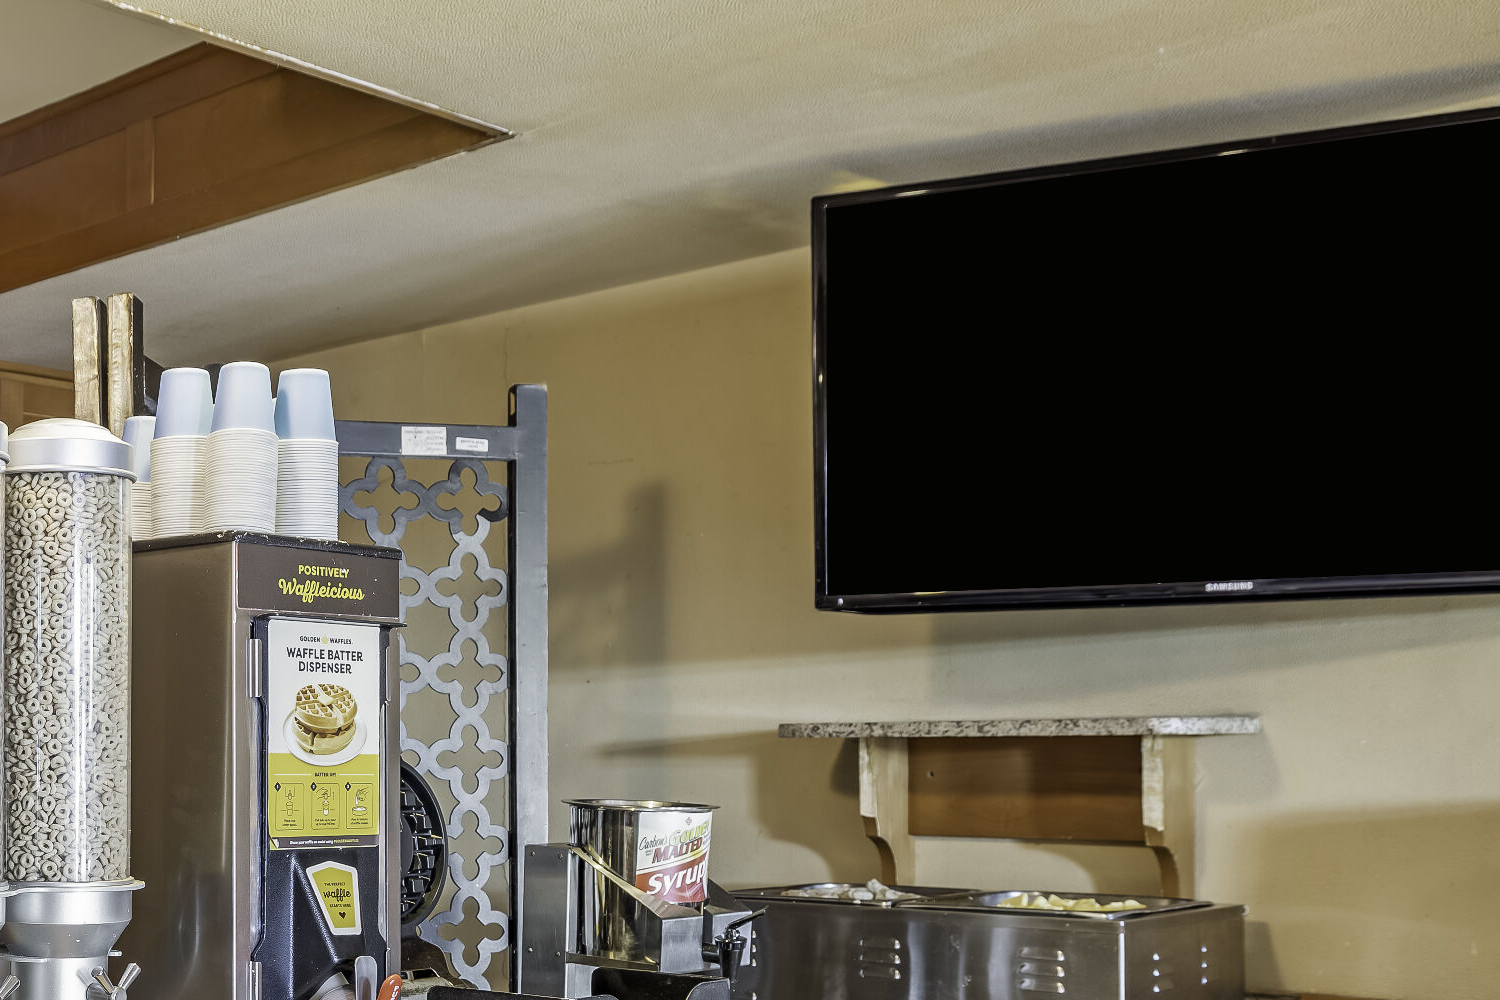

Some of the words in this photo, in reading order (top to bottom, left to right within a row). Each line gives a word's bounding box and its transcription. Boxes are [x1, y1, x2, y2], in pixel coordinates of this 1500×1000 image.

[298, 564, 350, 579] POSITIVELY
[278, 578, 365, 604] Waffleicious
[299, 635, 321, 643] GOLDEN
[286, 646, 325, 660] WAFFLE
[327, 649, 364, 662] BATTER
[298, 661, 352, 674] DISPENSER
[651, 837, 704, 864] MALTED
[647, 860, 706, 895] Syrup
[323, 888, 352, 902] waffle
